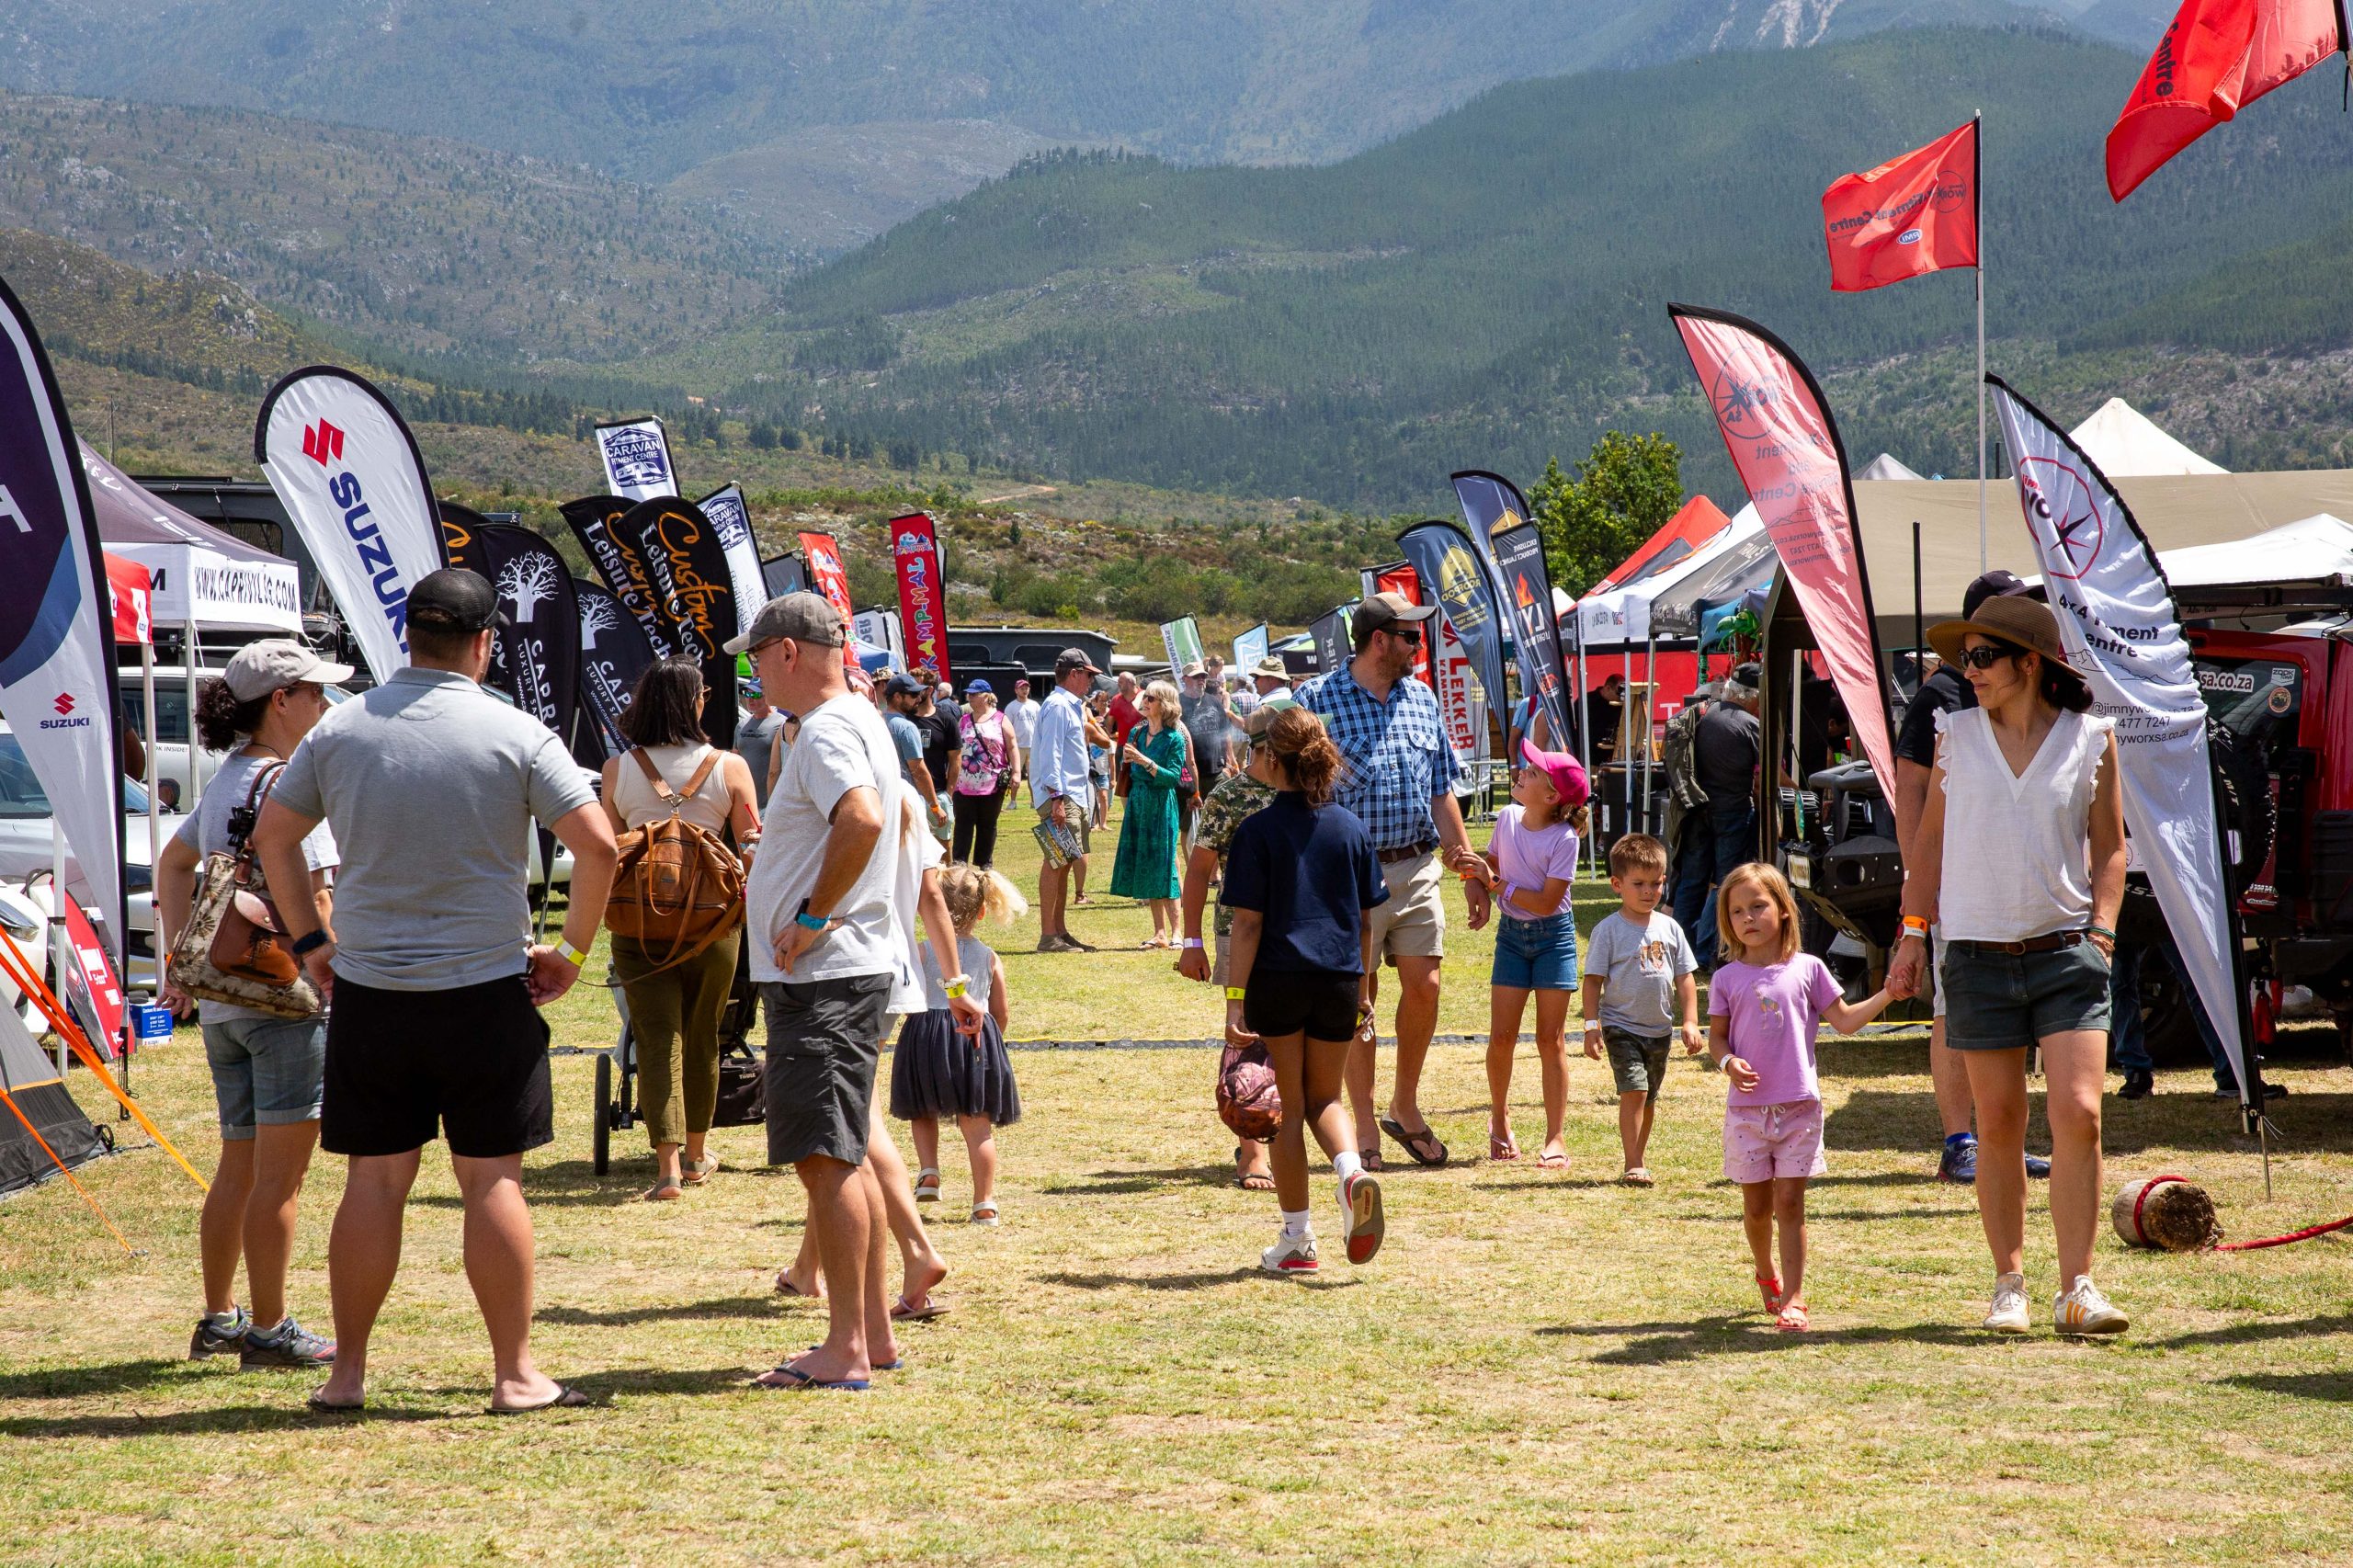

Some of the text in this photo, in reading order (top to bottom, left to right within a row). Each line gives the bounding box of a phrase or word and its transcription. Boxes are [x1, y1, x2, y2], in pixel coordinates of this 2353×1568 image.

[607, 440, 662, 458] CARAVAN
[635, 451, 659, 461] CENTRE
[710, 503, 741, 526] ARAVAN
[584, 518, 639, 606] Leisure
[659, 511, 728, 660] Custom
[2085, 632, 2139, 658] entre
[1449, 656, 1475, 750] LEKKER
[40, 717, 90, 730] SUZUKI
[2118, 715, 2171, 730] 477 7247
